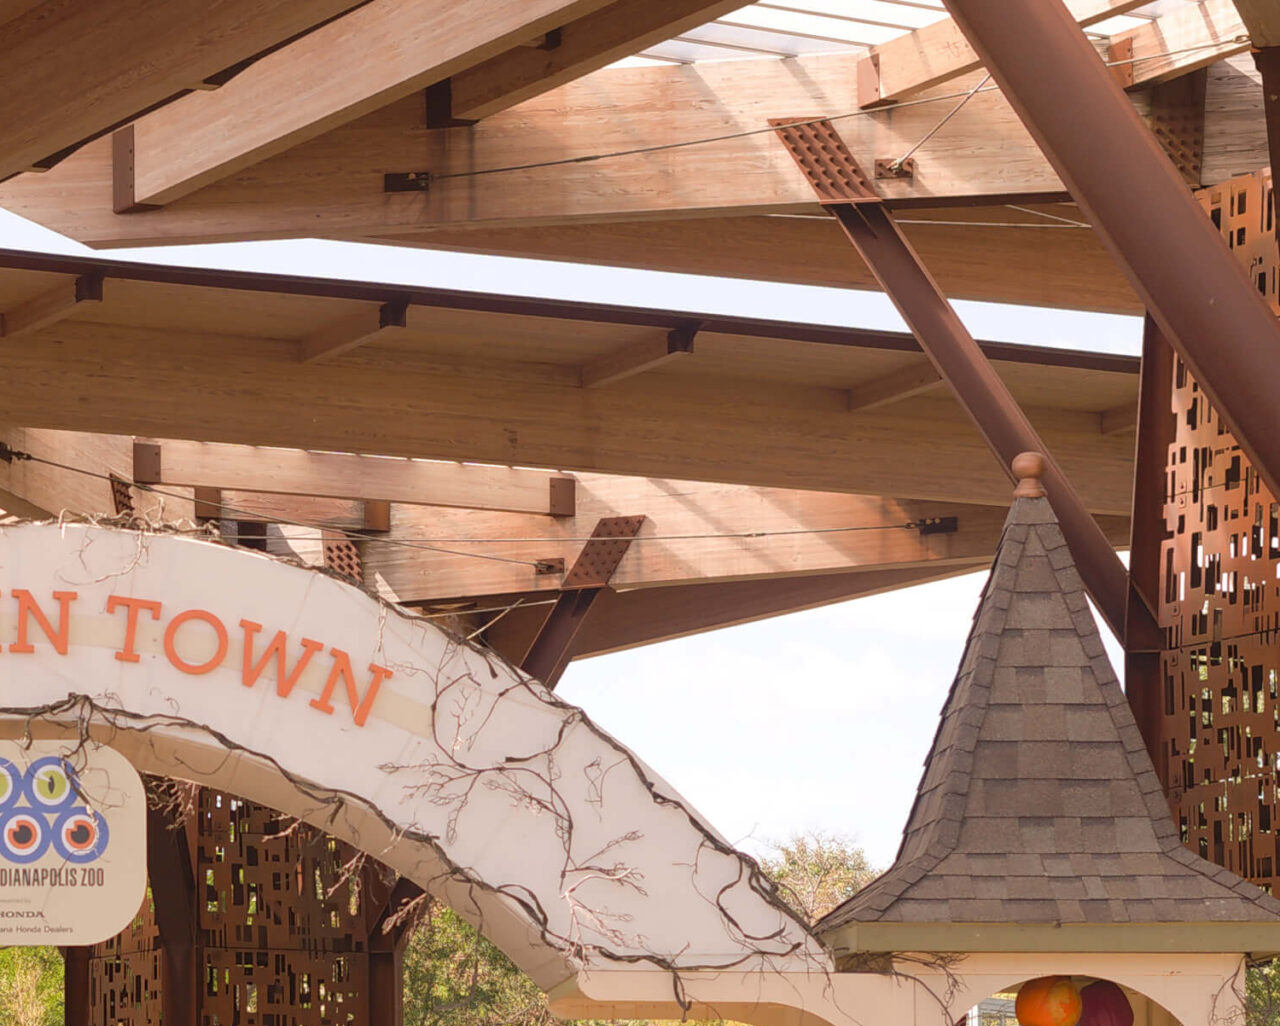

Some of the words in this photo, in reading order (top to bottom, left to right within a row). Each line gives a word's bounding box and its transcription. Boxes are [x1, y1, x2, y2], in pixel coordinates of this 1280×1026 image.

[106, 594, 394, 727] TOWN
[81, 868, 104, 887] ZOO
[16, 926, 41, 934] Honda
[44, 926, 73, 934] Dealers
